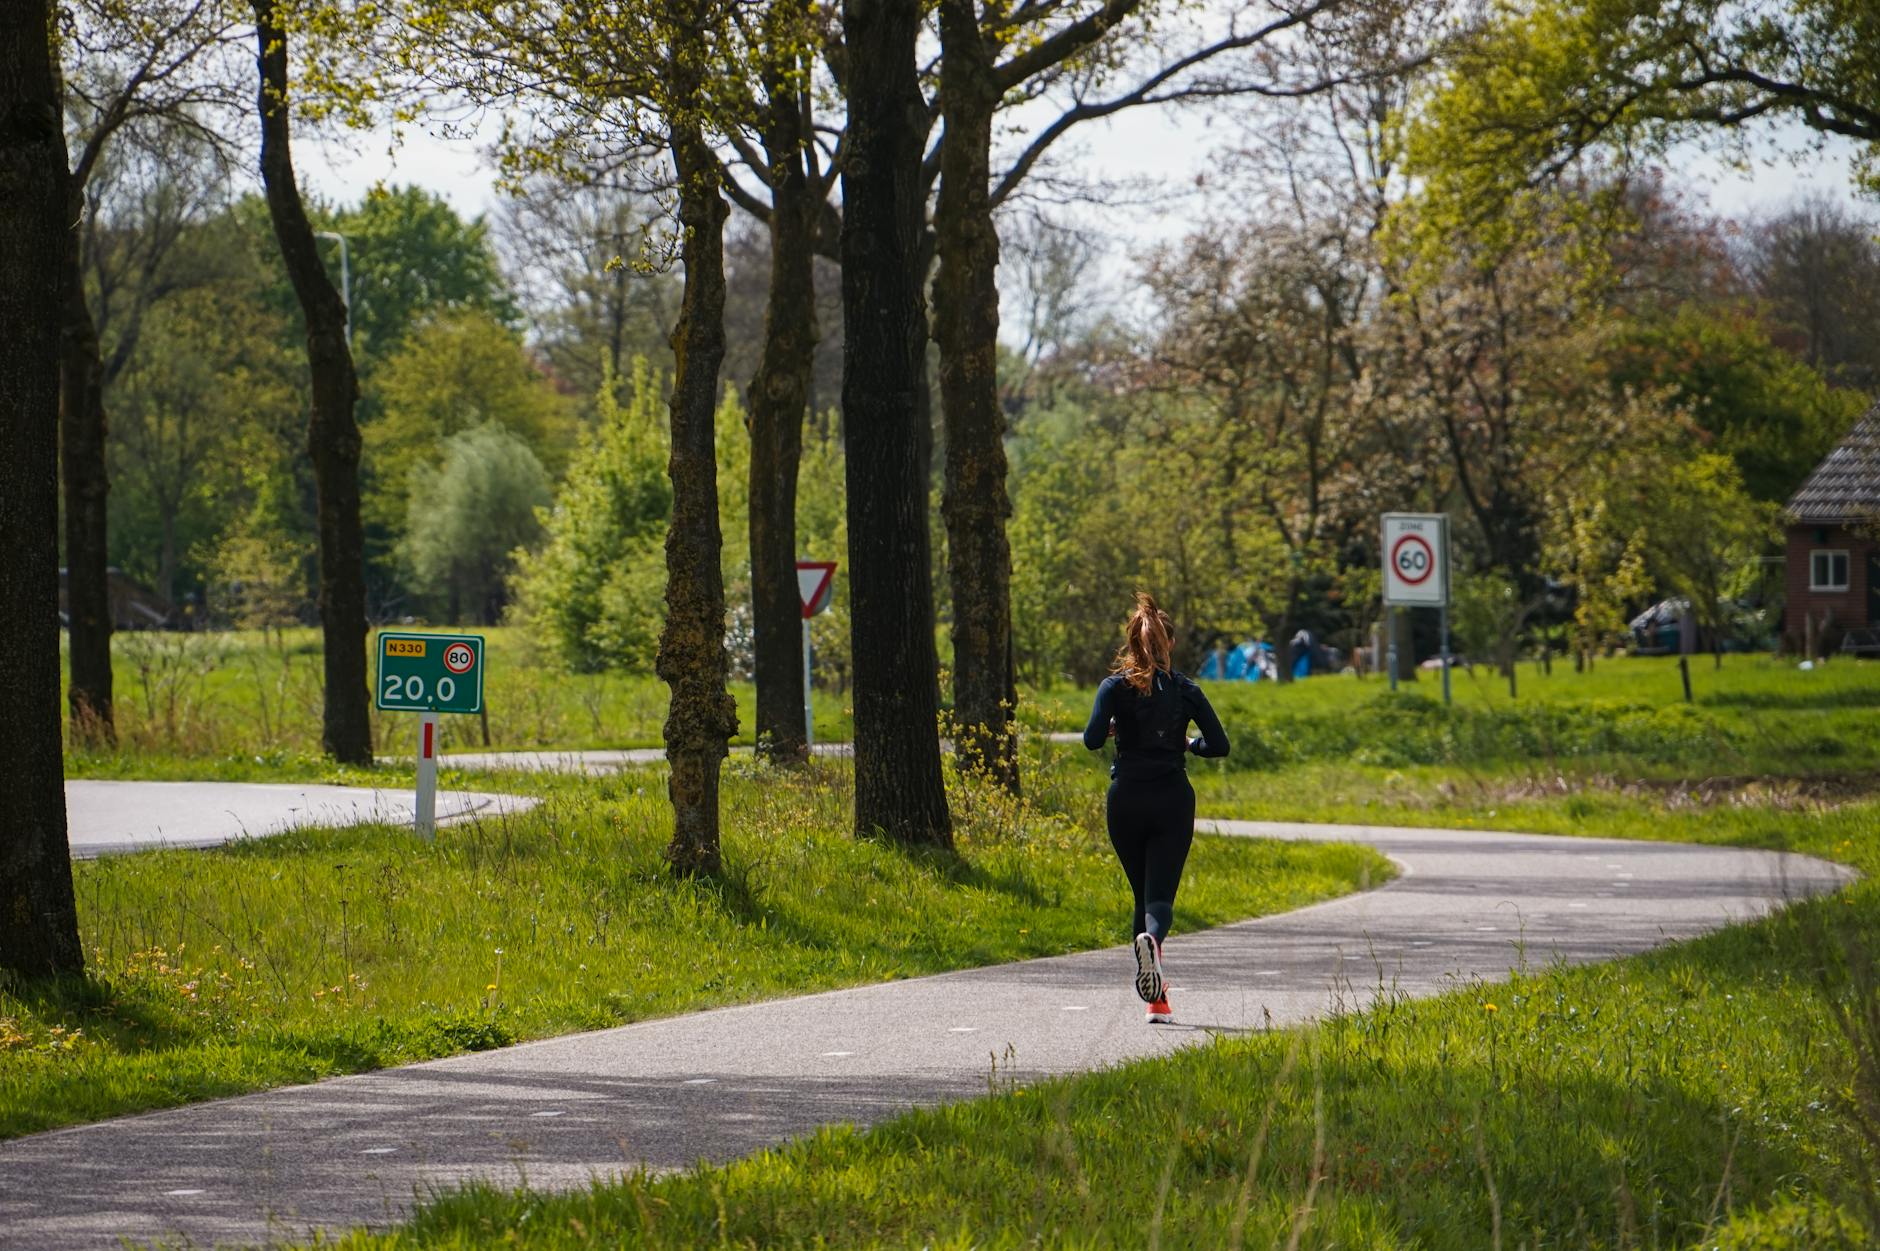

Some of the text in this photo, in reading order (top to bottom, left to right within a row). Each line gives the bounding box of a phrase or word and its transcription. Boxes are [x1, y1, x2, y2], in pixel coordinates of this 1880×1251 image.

[1400, 550, 1425, 570] 60
[389, 643, 423, 653] N330
[449, 652, 469, 664] 80
[384, 674, 455, 703] 20,0
